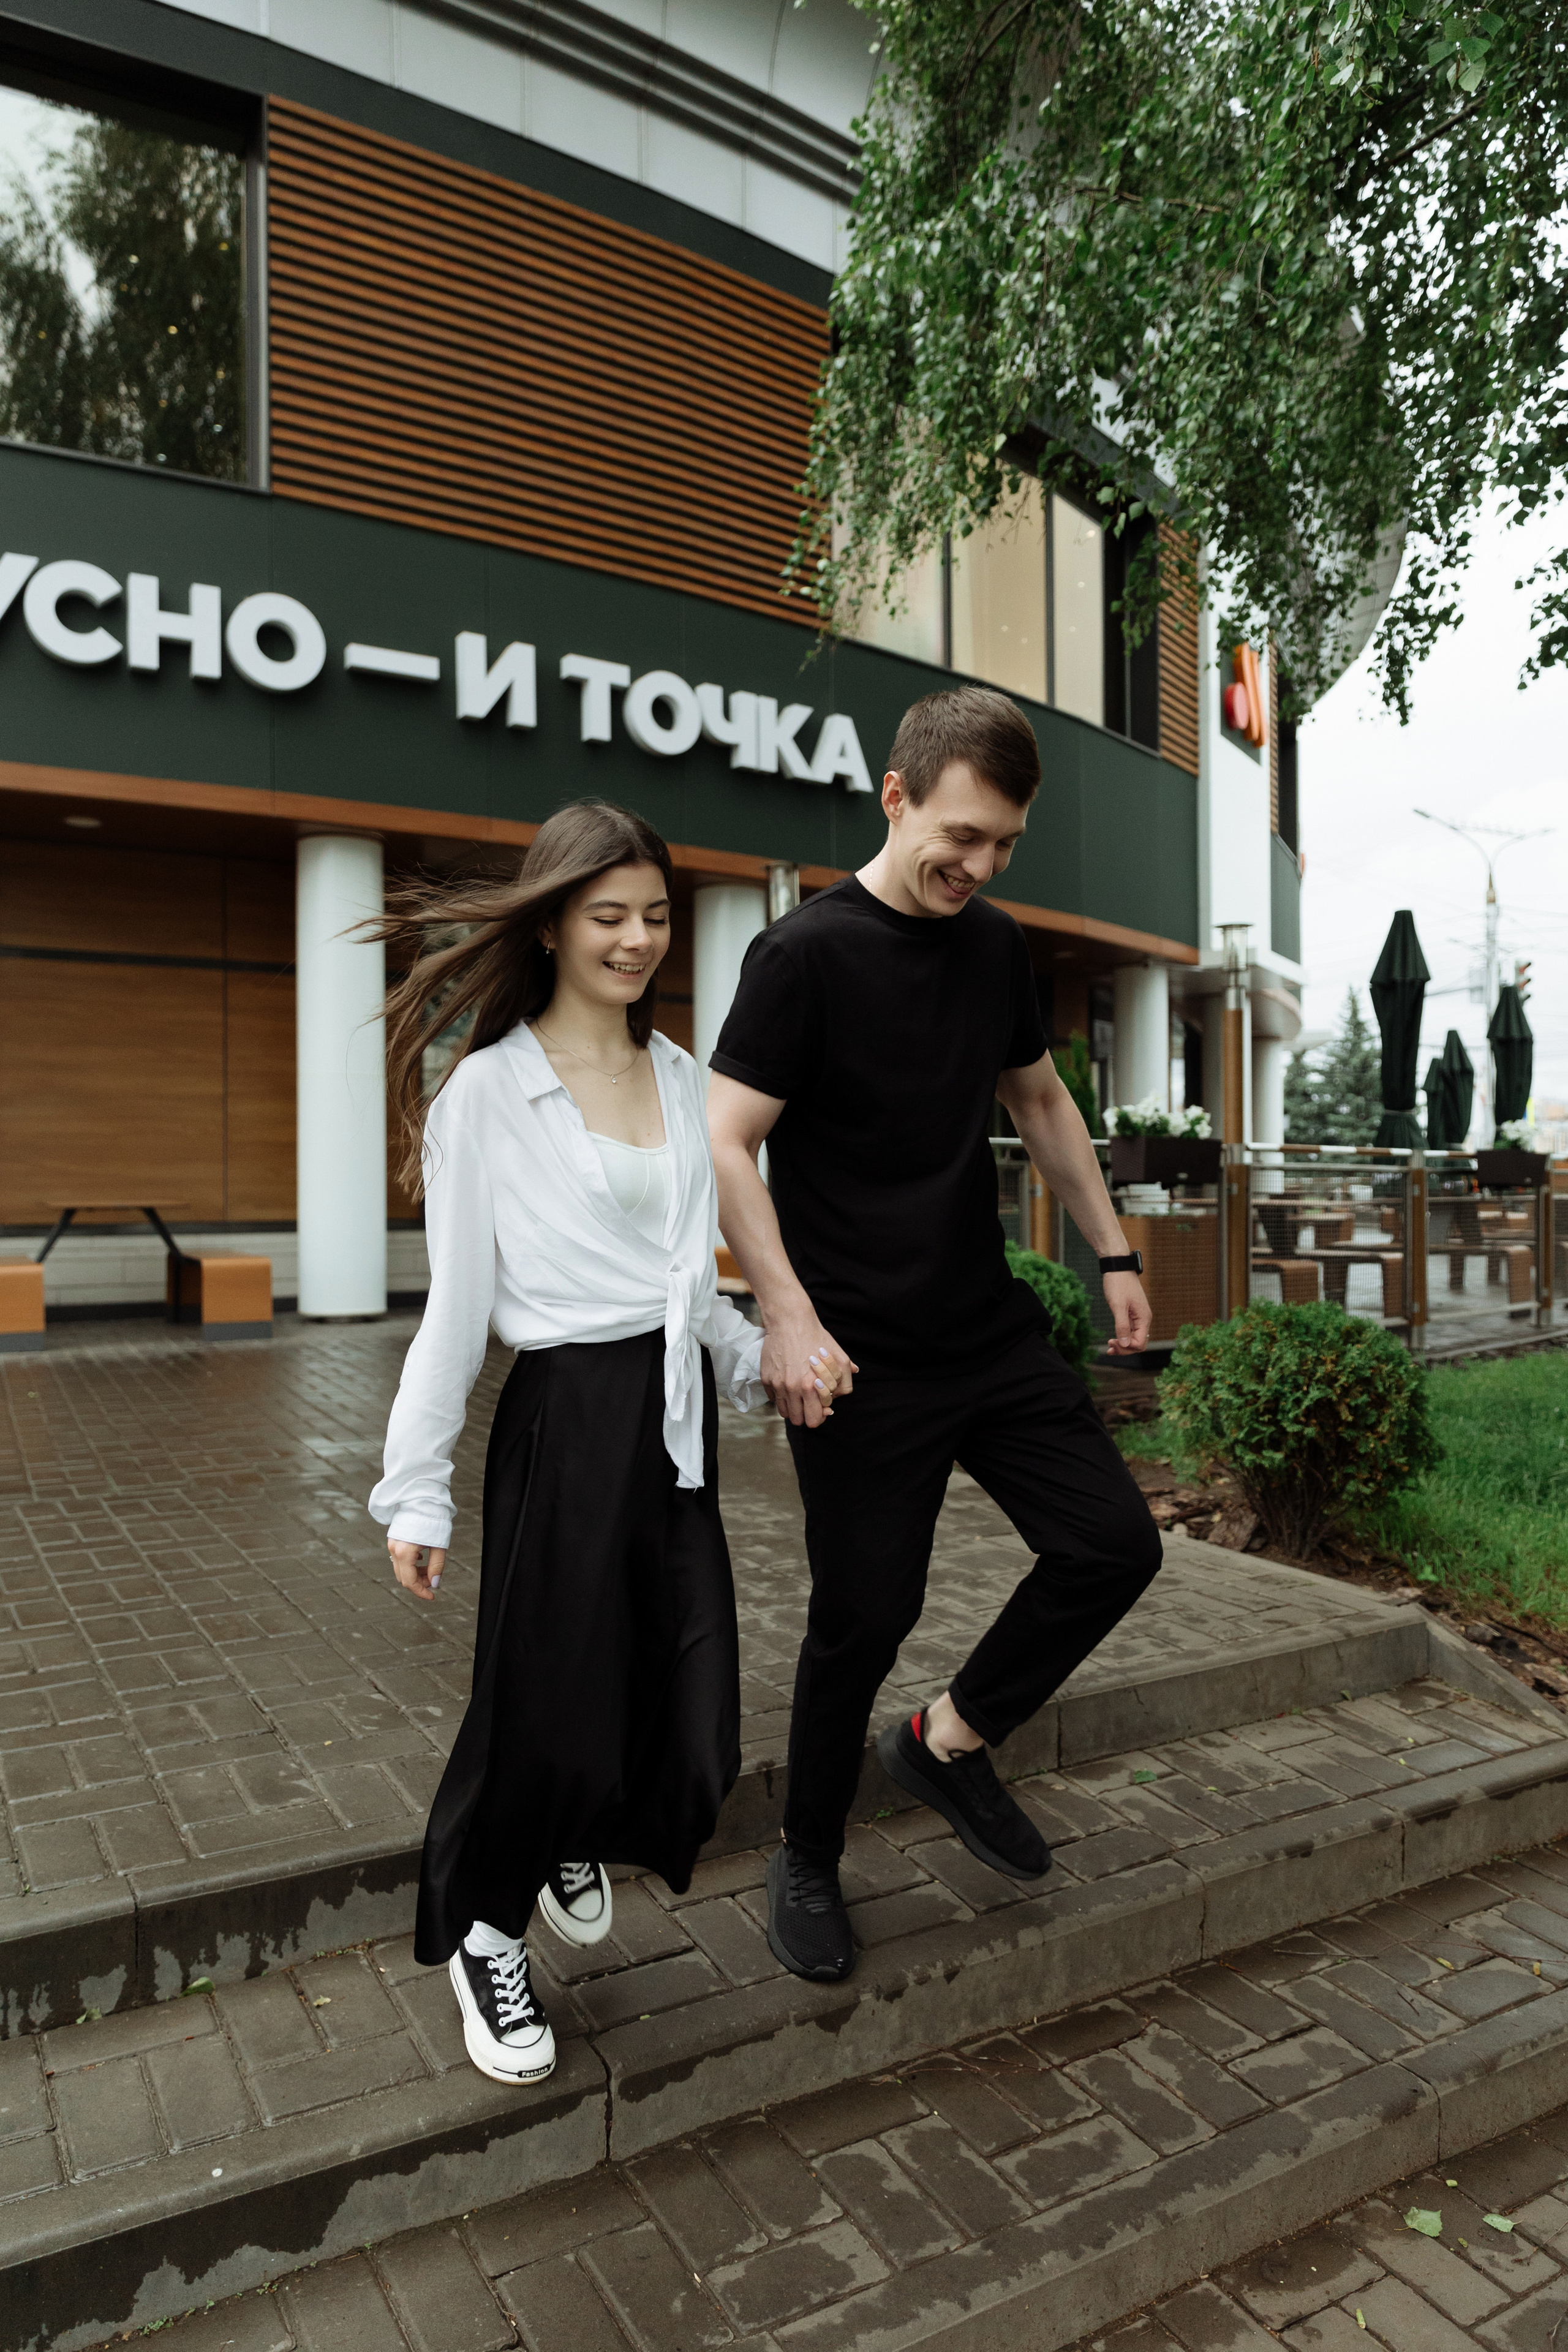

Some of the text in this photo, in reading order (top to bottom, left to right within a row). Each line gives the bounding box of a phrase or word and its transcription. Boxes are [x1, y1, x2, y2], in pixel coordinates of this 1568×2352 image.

[0, 552, 326, 693] СНО
[455, 630, 537, 729] И
[560, 652, 874, 793] ТОЧКА
[521, 2067, 548, 2078] Fashion
